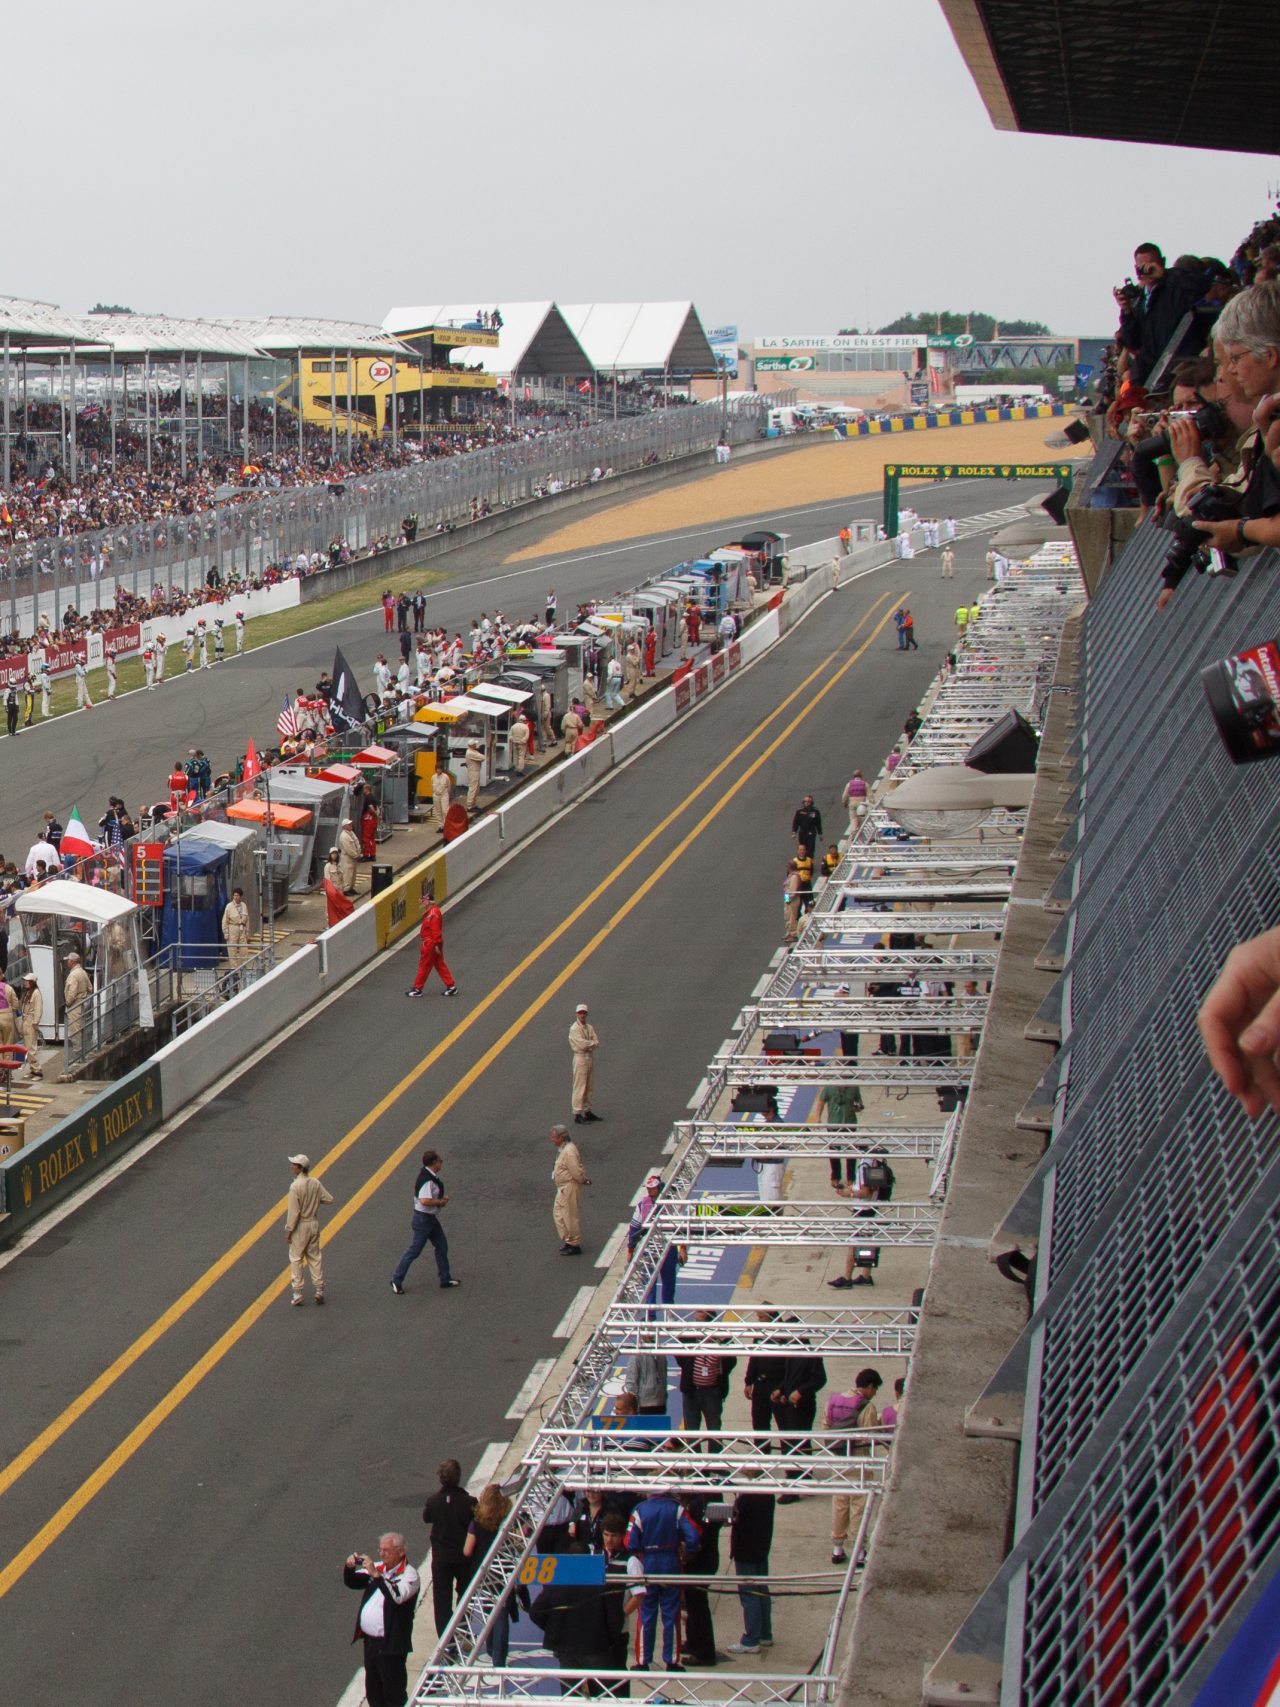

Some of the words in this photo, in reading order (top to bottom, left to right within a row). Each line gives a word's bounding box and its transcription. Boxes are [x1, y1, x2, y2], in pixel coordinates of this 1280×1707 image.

[762, 338, 776, 347] LA
[833, 338, 850, 347] ON
[872, 338, 892, 346] EST
[756, 361, 787, 370] Sarthe
[374, 368, 390, 376] D
[901, 466, 939, 476] ROLEX
[958, 467, 996, 476] ROLEX
[1016, 468, 1054, 476] ROLEX
[125, 635, 138, 647] Power
[61, 654, 70, 667] TDI
[8, 667, 25, 682] Power
[137, 846, 146, 858] 5
[103, 1091, 142, 1146] ROLEX
[39, 1134, 85, 1194] ROLEX
[520, 1556, 558, 1584] 88
